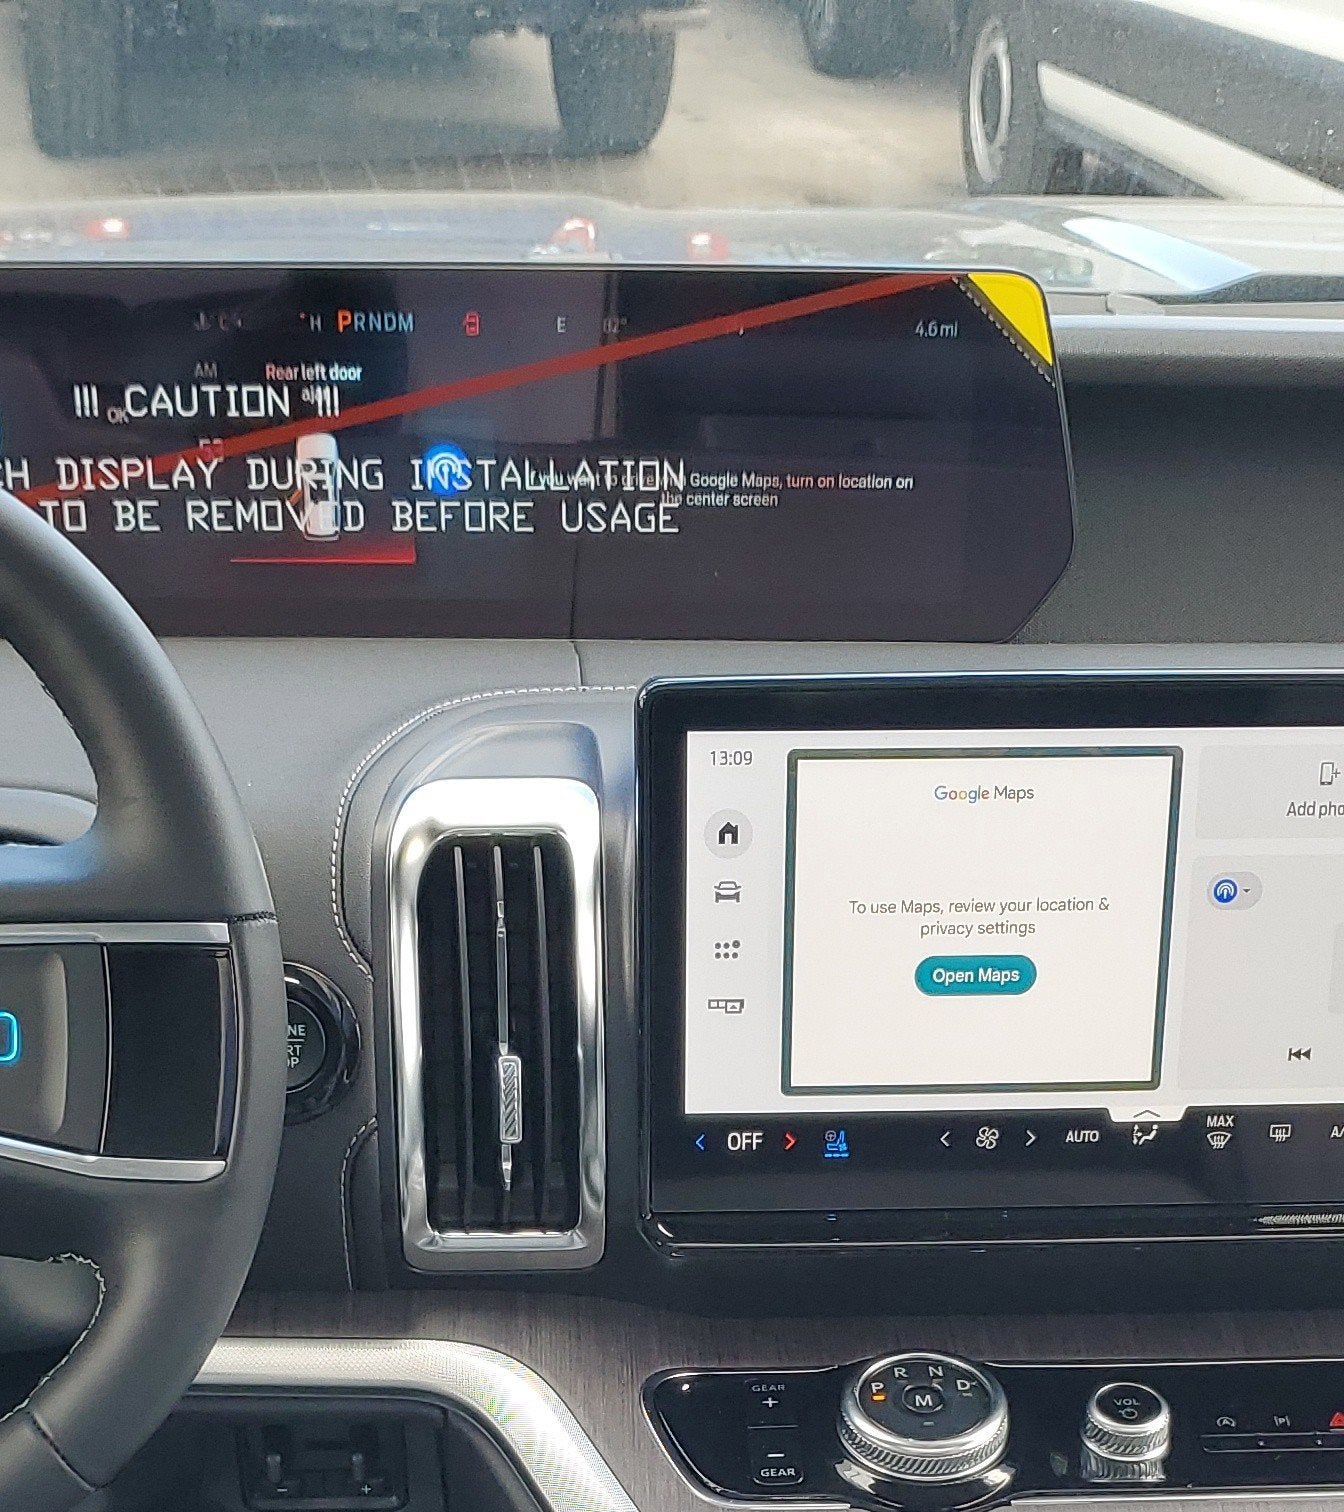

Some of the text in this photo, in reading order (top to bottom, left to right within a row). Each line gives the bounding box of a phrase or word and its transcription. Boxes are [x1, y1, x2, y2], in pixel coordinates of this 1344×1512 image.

[266, 361, 363, 382] Rear left door
[125, 383, 291, 418] CAUTION
[56, 457, 220, 492] DISPLAY
[246, 457, 384, 491] DURING
[410, 457, 685, 492] INSTALLATION
[690, 472, 738, 490] Google
[741, 472, 783, 490] Maps,
[786, 473, 814, 489] turn
[818, 475, 835, 489] on
[838, 471, 894, 489] location
[896, 475, 914, 490] on
[686, 493, 730, 508] center
[733, 494, 778, 508] screen
[38, 499, 87, 532] TO
[114, 499, 161, 532] BE
[392, 500, 535, 533] BEFORE
[561, 499, 680, 533] USAGE
[710, 750, 753, 767] 13:09
[934, 785, 1035, 804] Google Maps
[1286, 801, 1316, 816] Add
[849, 896, 1110, 917] To use Maps, review your location &
[920, 919, 1036, 939] privacy settings
[932, 967, 1021, 985] Open Maps
[1206, 1115, 1235, 1129] MAX
[727, 1133, 763, 1152] OFF
[1065, 1129, 1100, 1144] AUTO
[894, 1366, 944, 1378] R N
[871, 1382, 885, 1393] P
[915, 1394, 933, 1407] M
[1113, 1398, 1141, 1406] VOL
[760, 1467, 796, 1477] GEAR
